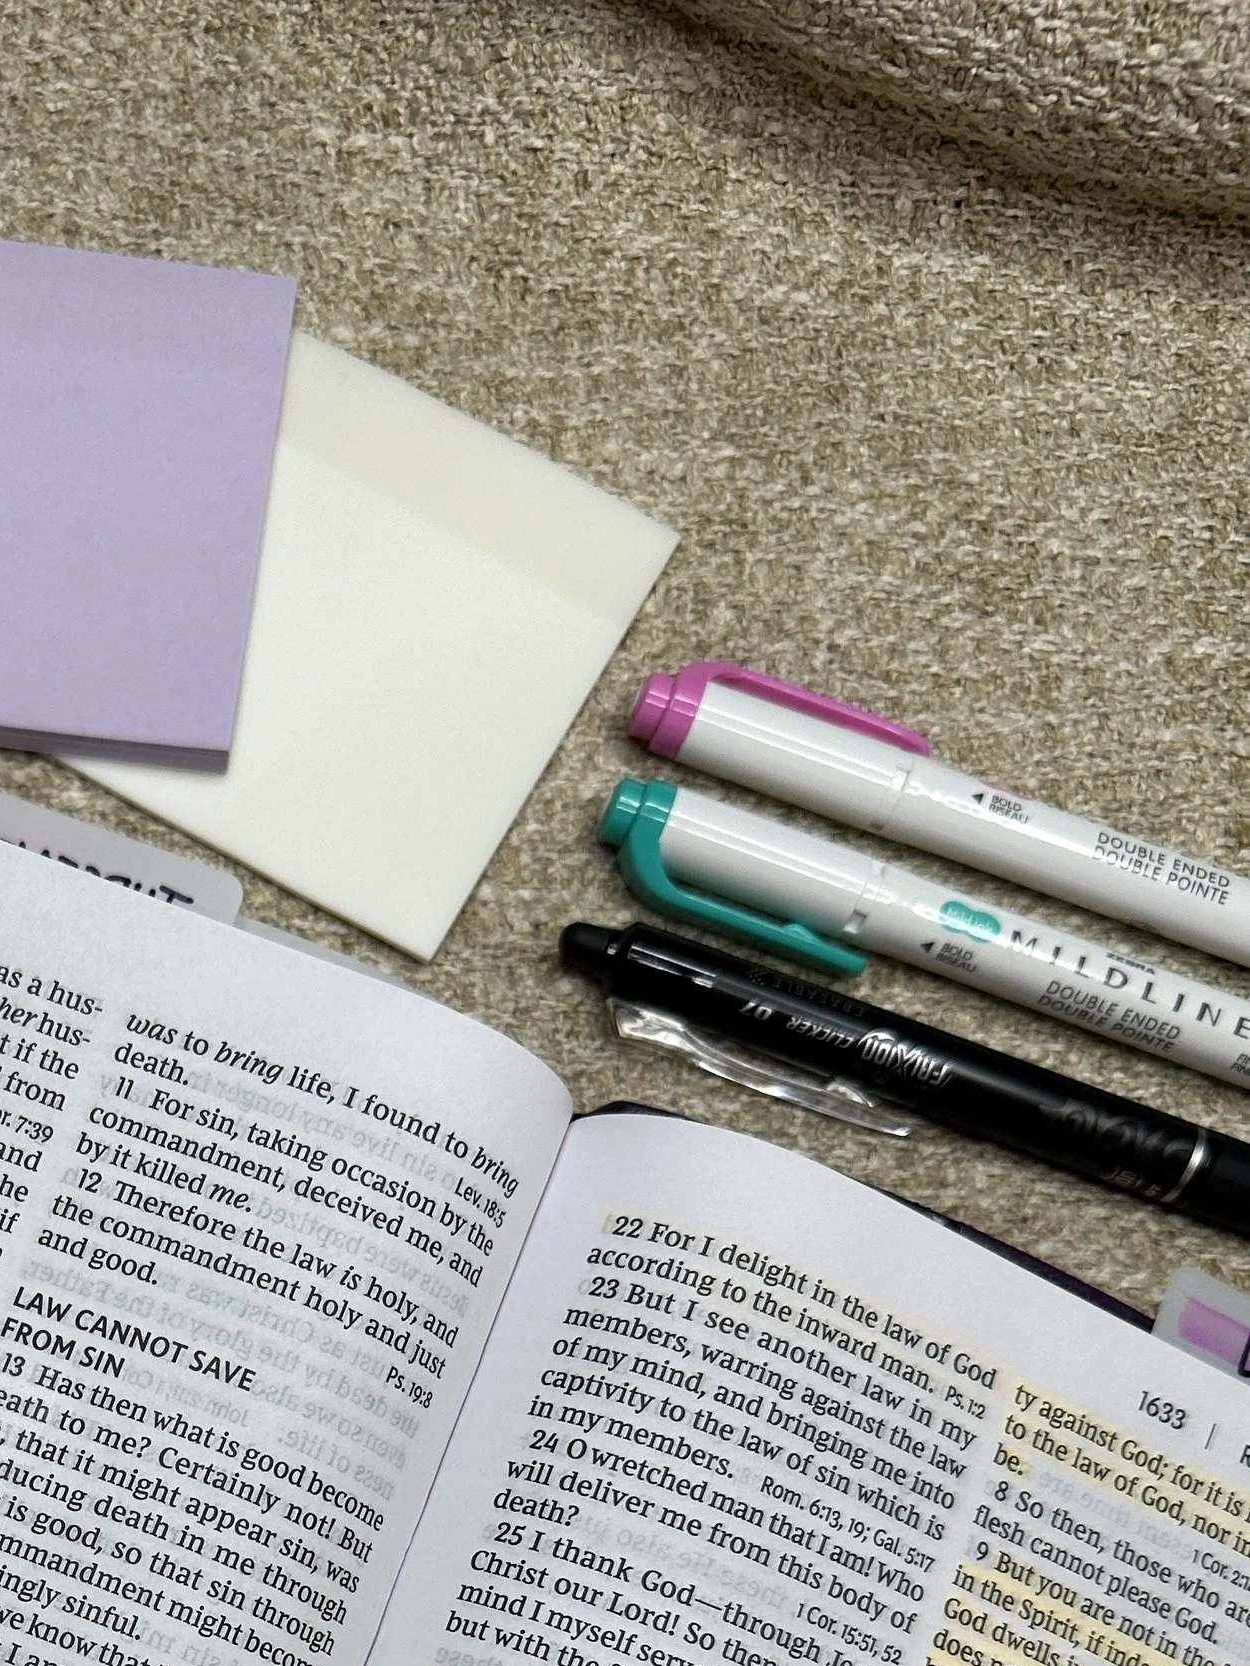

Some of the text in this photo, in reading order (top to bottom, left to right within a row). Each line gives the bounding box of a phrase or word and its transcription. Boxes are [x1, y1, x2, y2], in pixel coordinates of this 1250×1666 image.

[1092, 845, 1231, 906] DOUBLE POINTE
[1097, 831, 1231, 889] DOUBLE ENDED
[941, 942, 973, 962] BOLD
[1106, 952, 1156, 976] ZEBRA
[27, 978, 42, 997] a
[46, 980, 102, 1015] hus-
[1046, 979, 1182, 1041] DOUBLE ENDED
[785, 1015, 855, 1050] CLICKER
[1036, 994, 1176, 1053] DOUBLE POINTE
[15, 1115, 54, 1143] 7:39
[454, 1177, 506, 1228] Lev. 18:5
[612, 1216, 997, 1390] 22 For I delight in the law of God
[0, 1317, 125, 1378] FROM SIN
[13, 1286, 256, 1392] LAW CANNOT SAVE
[386, 1365, 433, 1409] Ps. 19:8
[944, 1385, 986, 1420] Ps. 1:2
[1139, 1391, 1186, 1430] 1633
